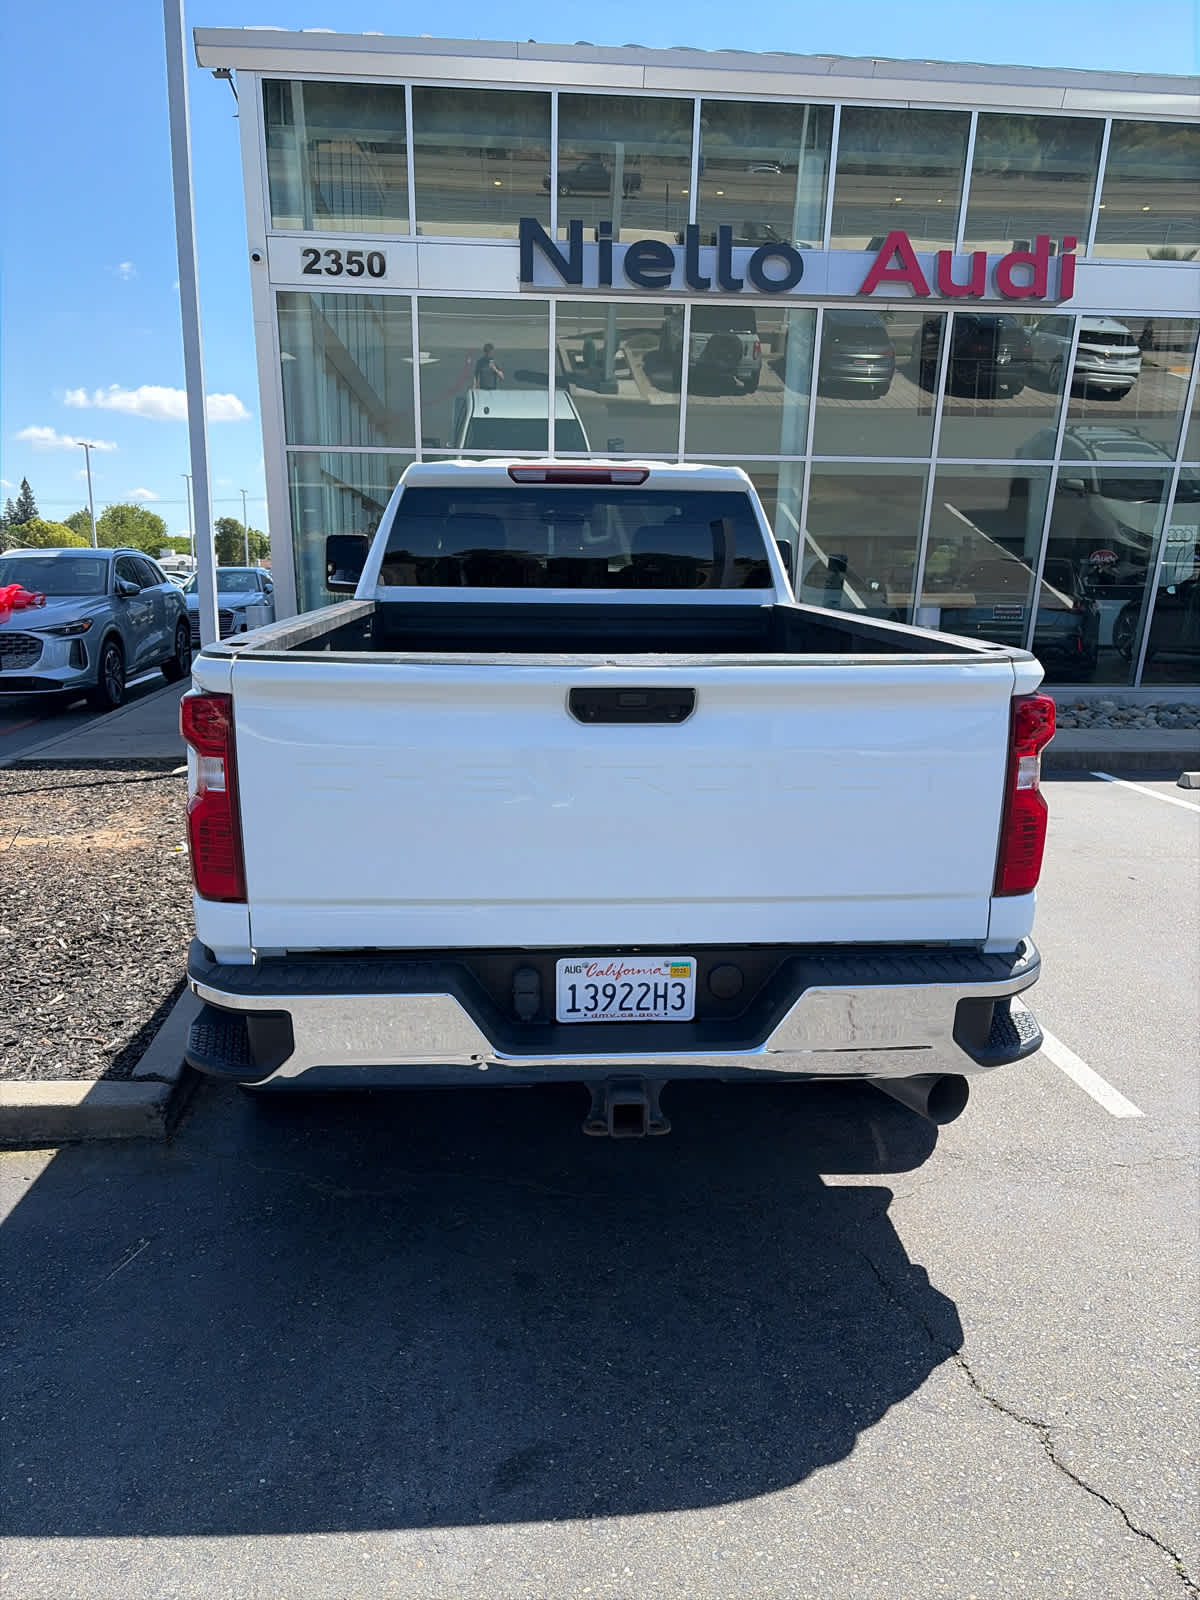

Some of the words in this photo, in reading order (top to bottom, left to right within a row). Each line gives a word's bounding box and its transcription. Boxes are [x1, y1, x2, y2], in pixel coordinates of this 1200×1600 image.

[302, 248, 386, 278] 2350
[519, 217, 804, 293] Niello
[857, 230, 1078, 299] Audi
[564, 965, 582, 974] AUG
[586, 962, 671, 981] California
[566, 982, 686, 1013] 13922H3
